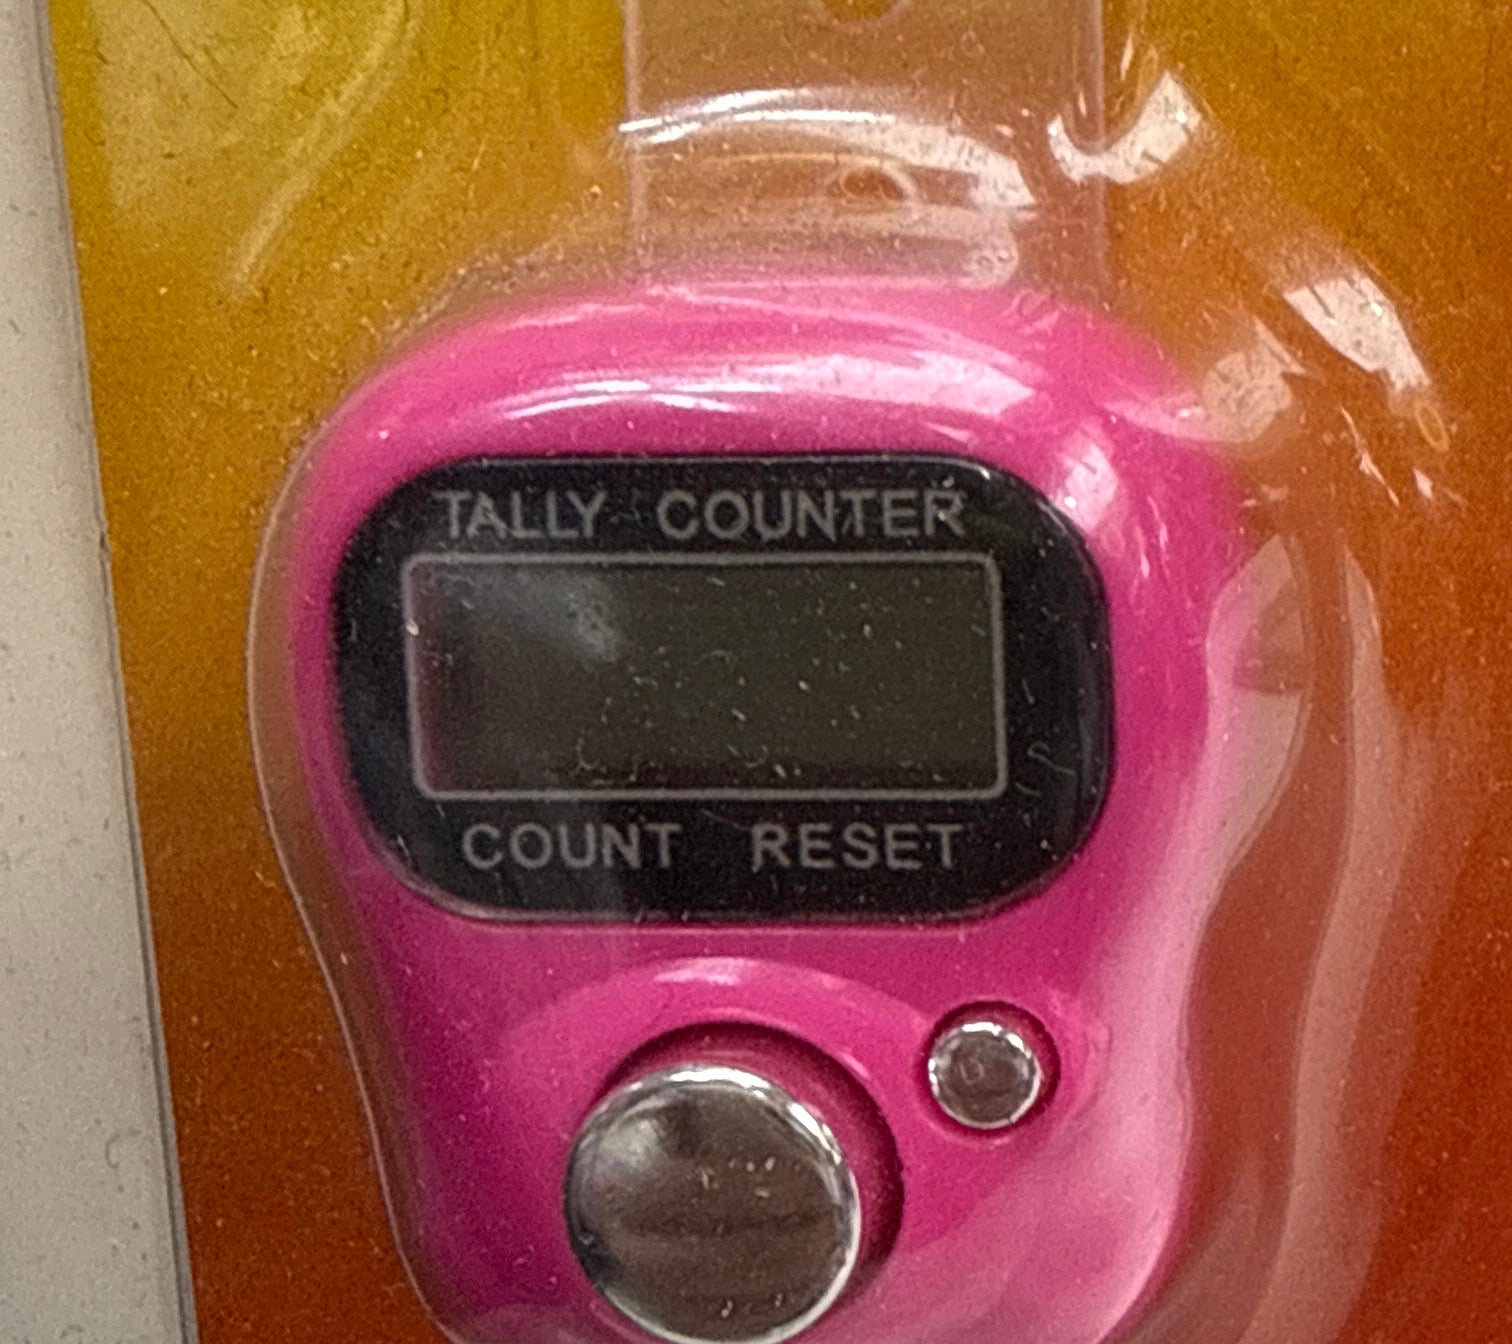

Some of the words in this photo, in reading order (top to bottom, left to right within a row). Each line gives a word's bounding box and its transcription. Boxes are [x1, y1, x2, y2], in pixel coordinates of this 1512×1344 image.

[438, 490, 603, 540] TALLY
[657, 488, 967, 540] COUNTER
[463, 822, 682, 870] COUNT
[752, 822, 965, 871] RESET
